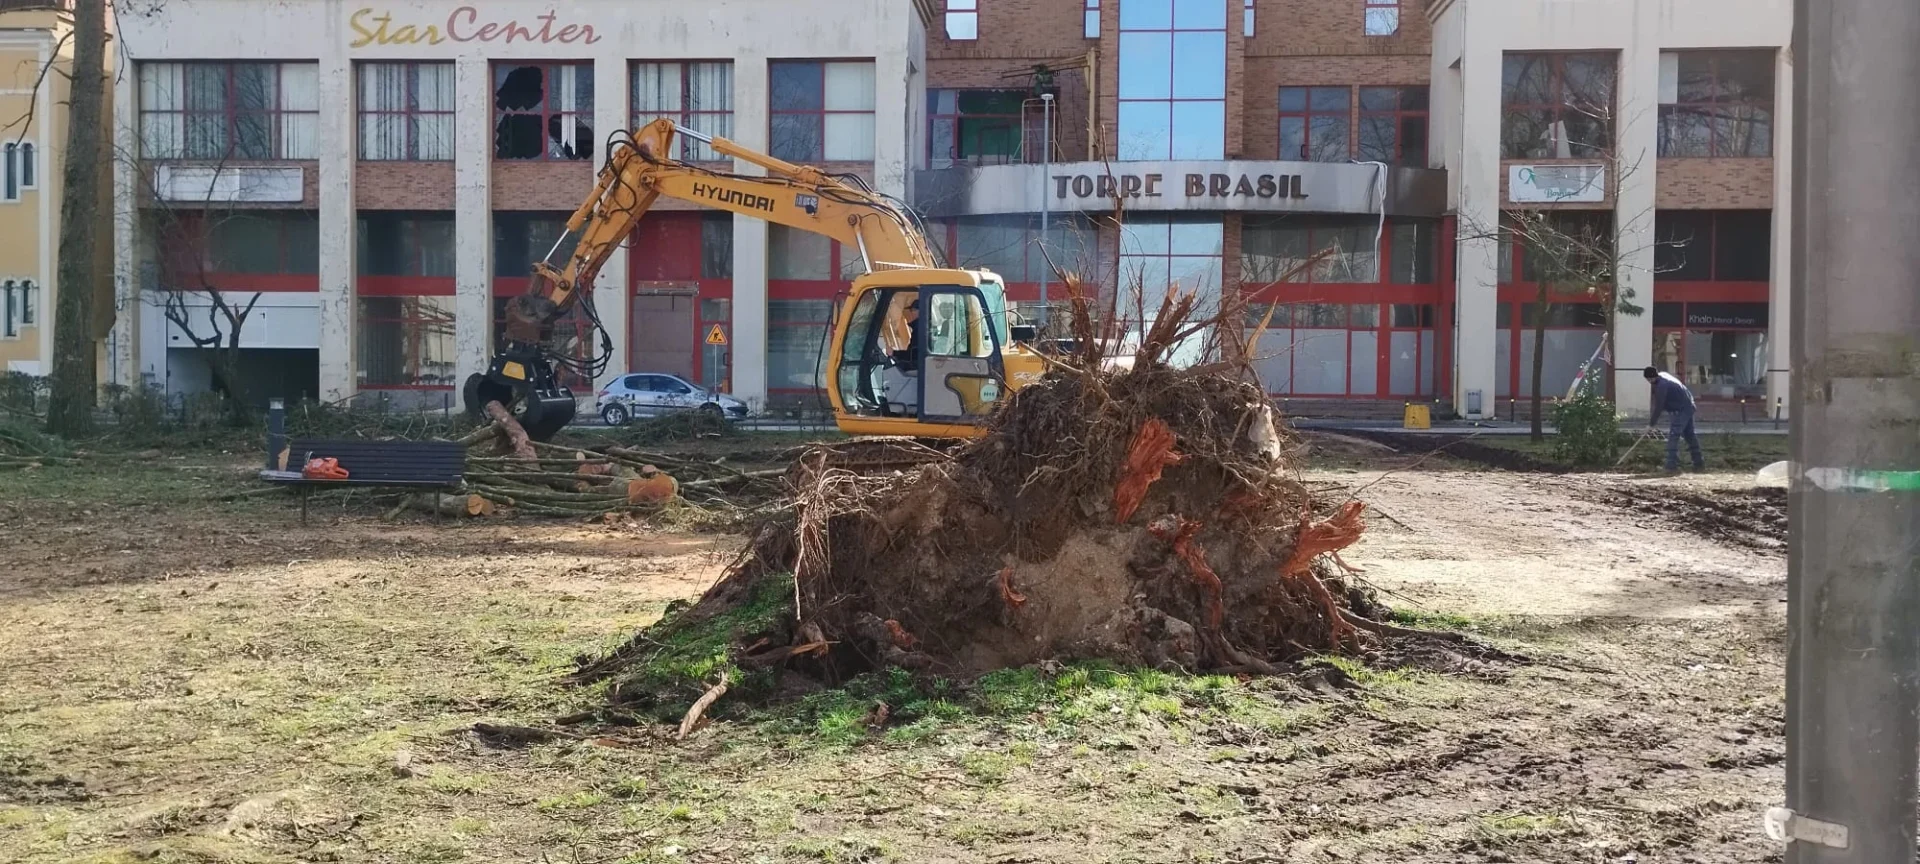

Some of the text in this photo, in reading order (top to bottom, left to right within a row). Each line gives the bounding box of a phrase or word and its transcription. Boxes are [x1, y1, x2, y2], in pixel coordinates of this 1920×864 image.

[692, 182, 775, 213] HYUNDAI
[1051, 173, 1309, 199] TORRE BRASIL
